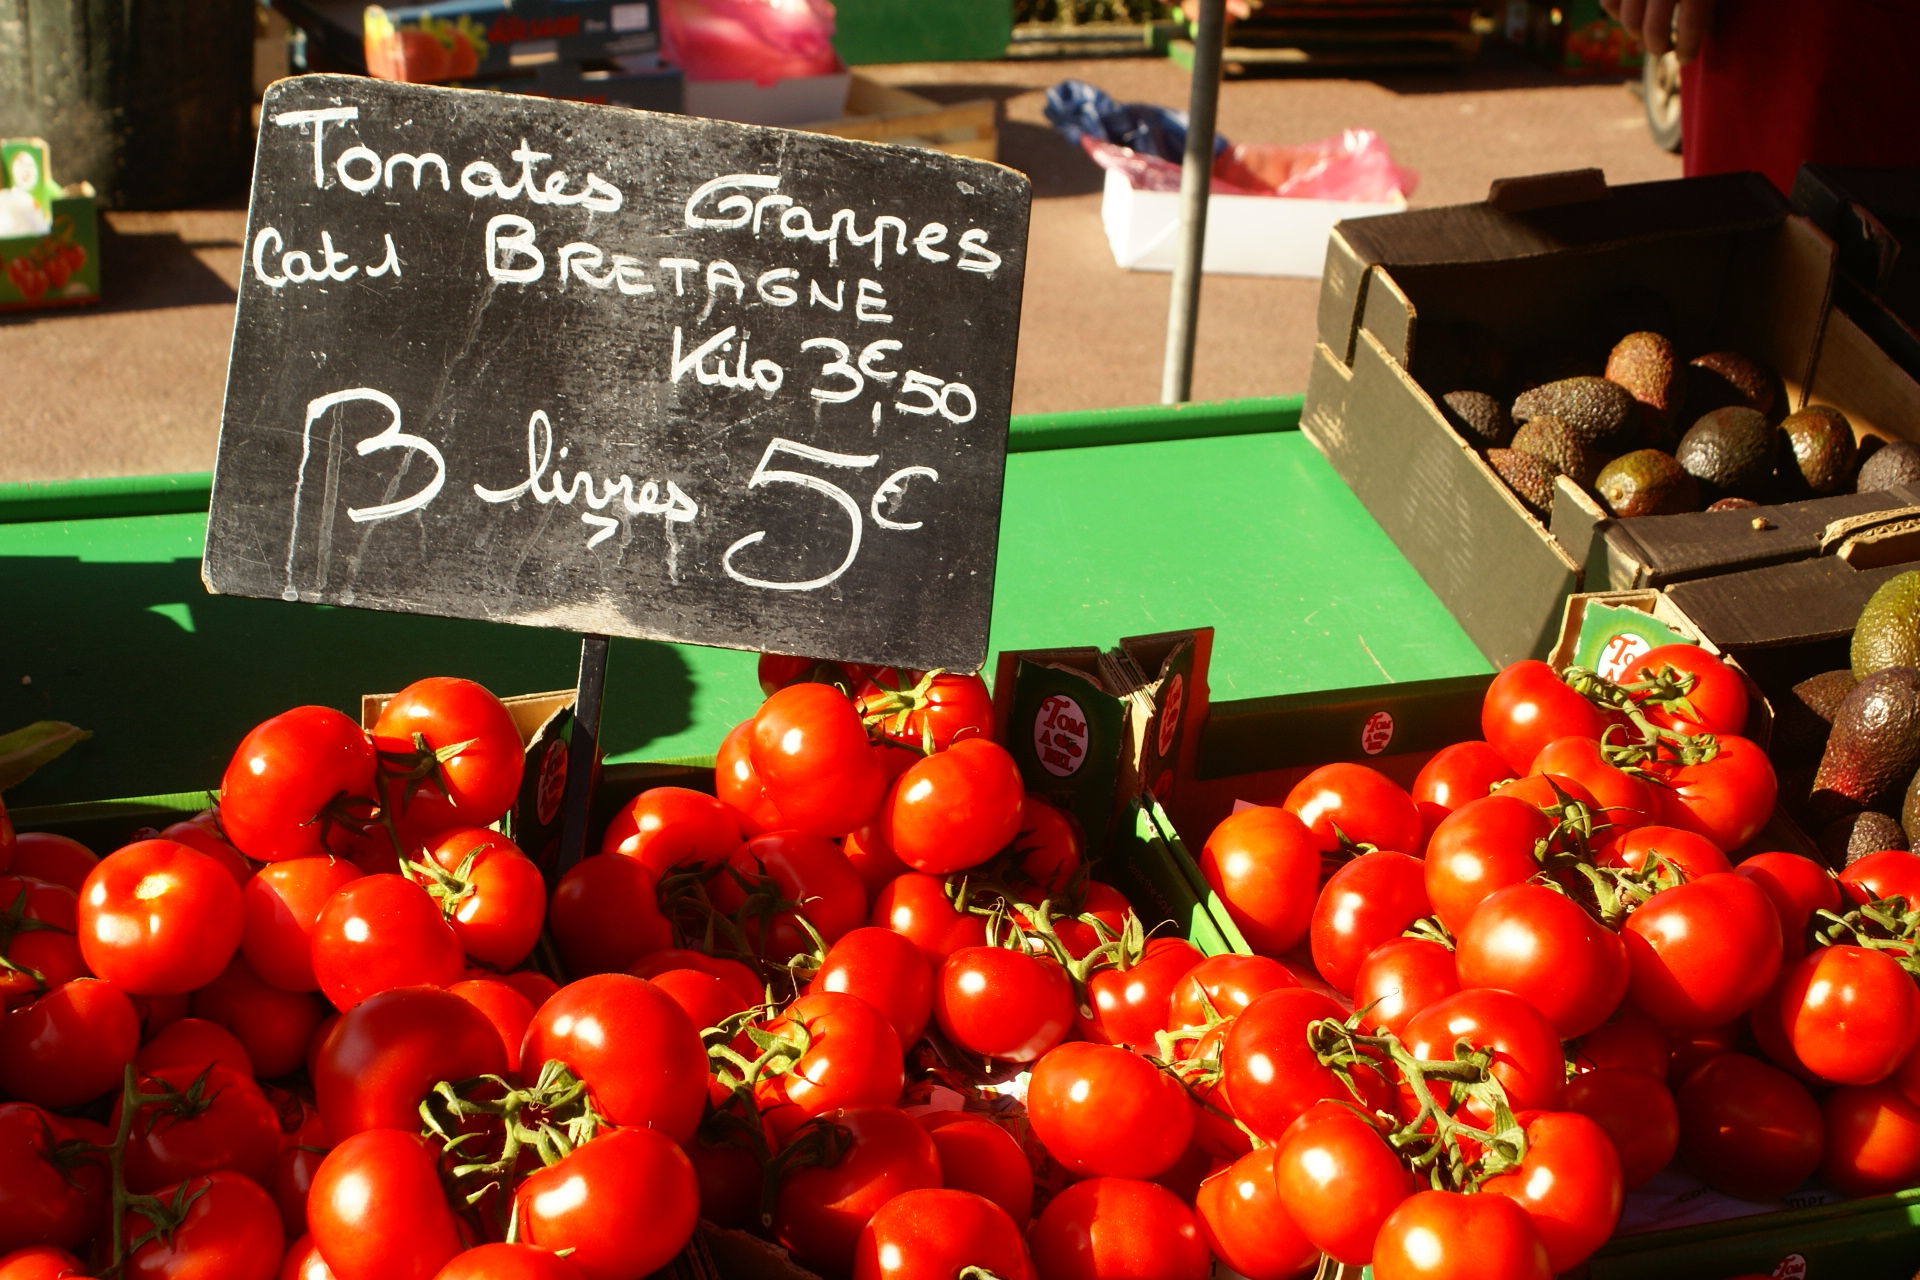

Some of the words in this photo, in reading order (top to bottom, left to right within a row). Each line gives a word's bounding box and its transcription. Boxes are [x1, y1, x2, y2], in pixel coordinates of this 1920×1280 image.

[275, 106, 623, 213] Tomates
[685, 174, 1002, 274] Grappes
[253, 227, 360, 288] Cat
[485, 214, 895, 324] BRETAGNE
[671, 326, 784, 394] Kilo
[473, 409, 699, 523] livres
